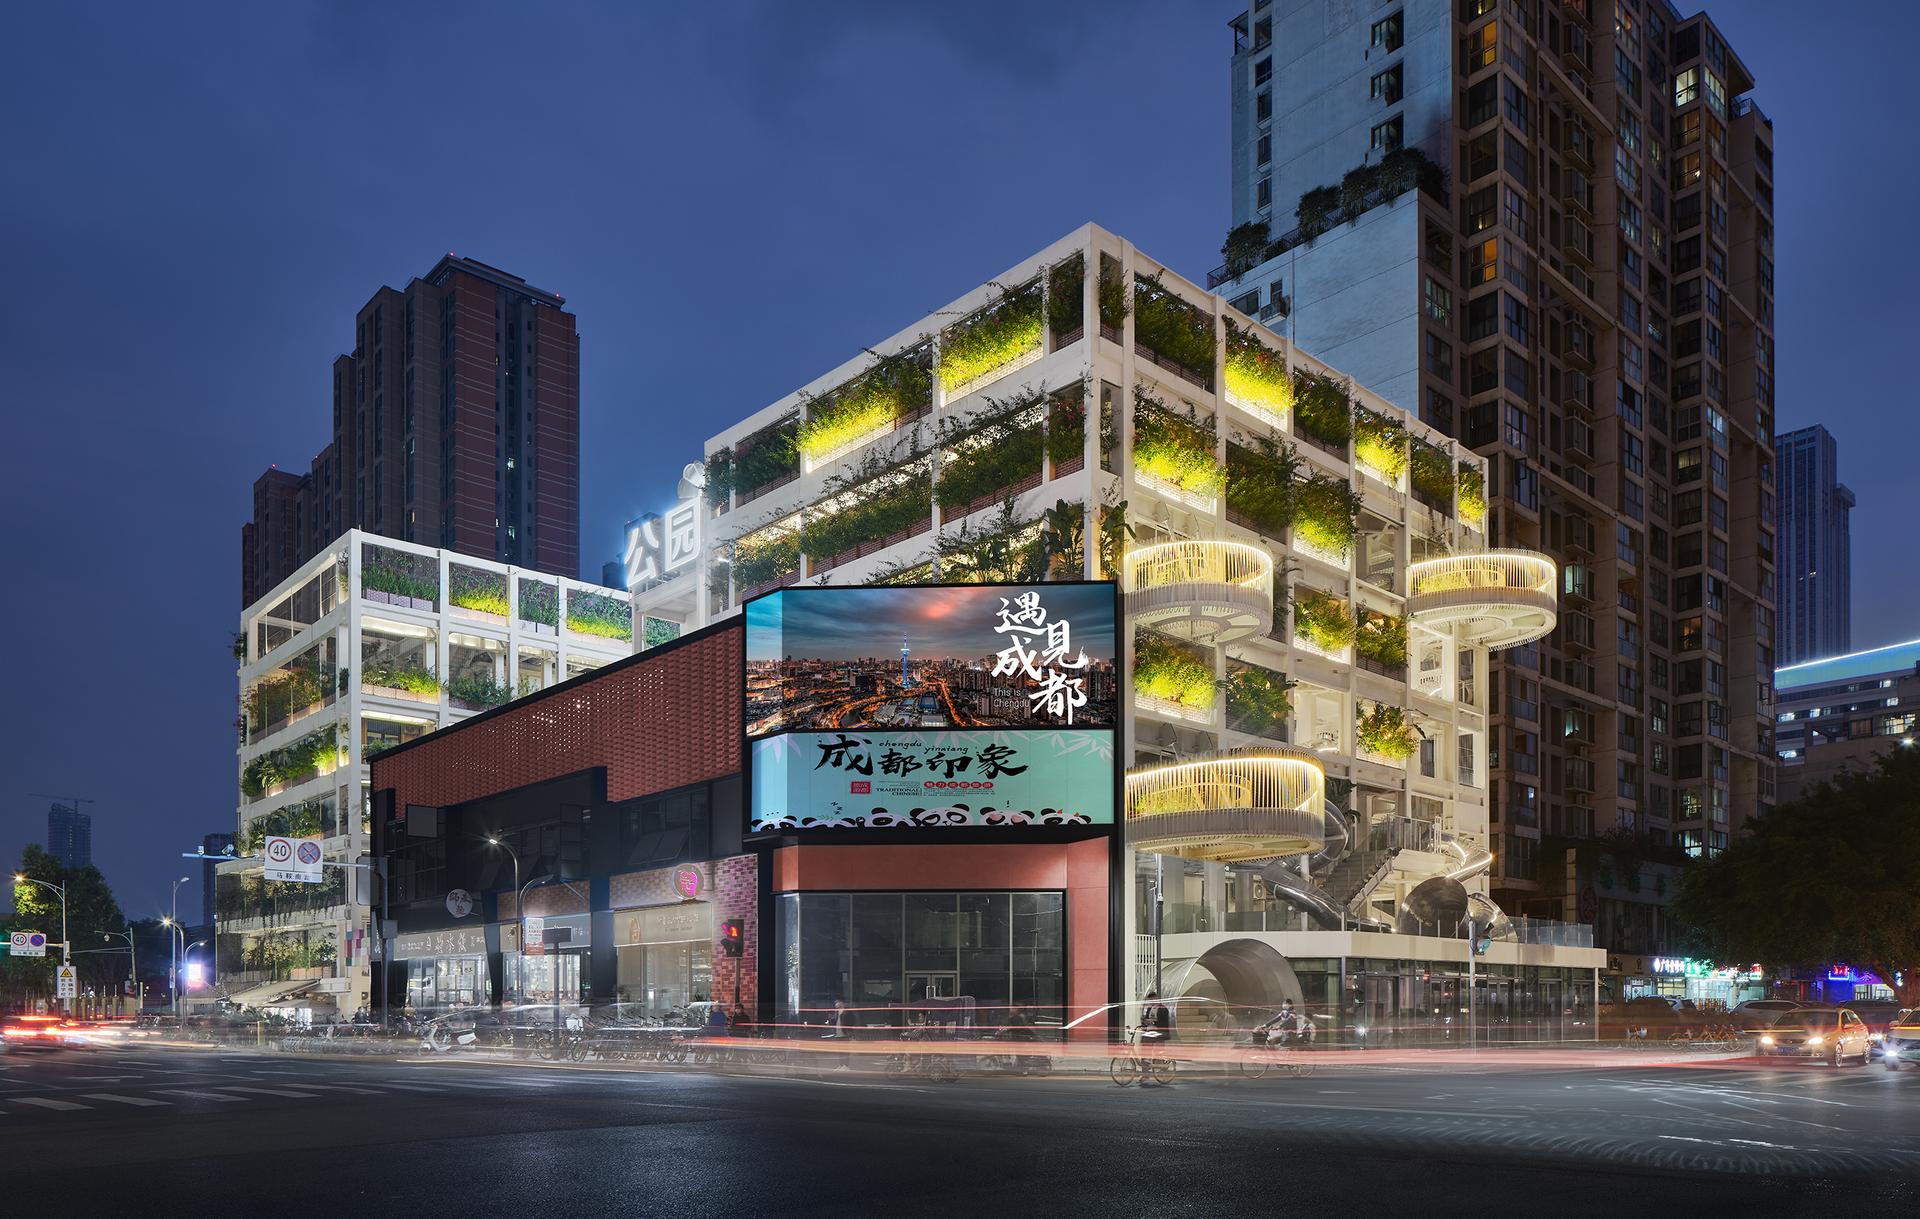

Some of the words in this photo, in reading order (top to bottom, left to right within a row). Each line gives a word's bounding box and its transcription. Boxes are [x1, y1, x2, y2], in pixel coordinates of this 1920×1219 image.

[624, 497, 703, 587] 公园
[991, 634, 1087, 725] 成都
[995, 688, 1011, 697] This
[993, 699, 1030, 709] Chengdu
[879, 740, 922, 749] chengdu
[814, 733, 1029, 778] 成都印象
[274, 845, 287, 857] 40
